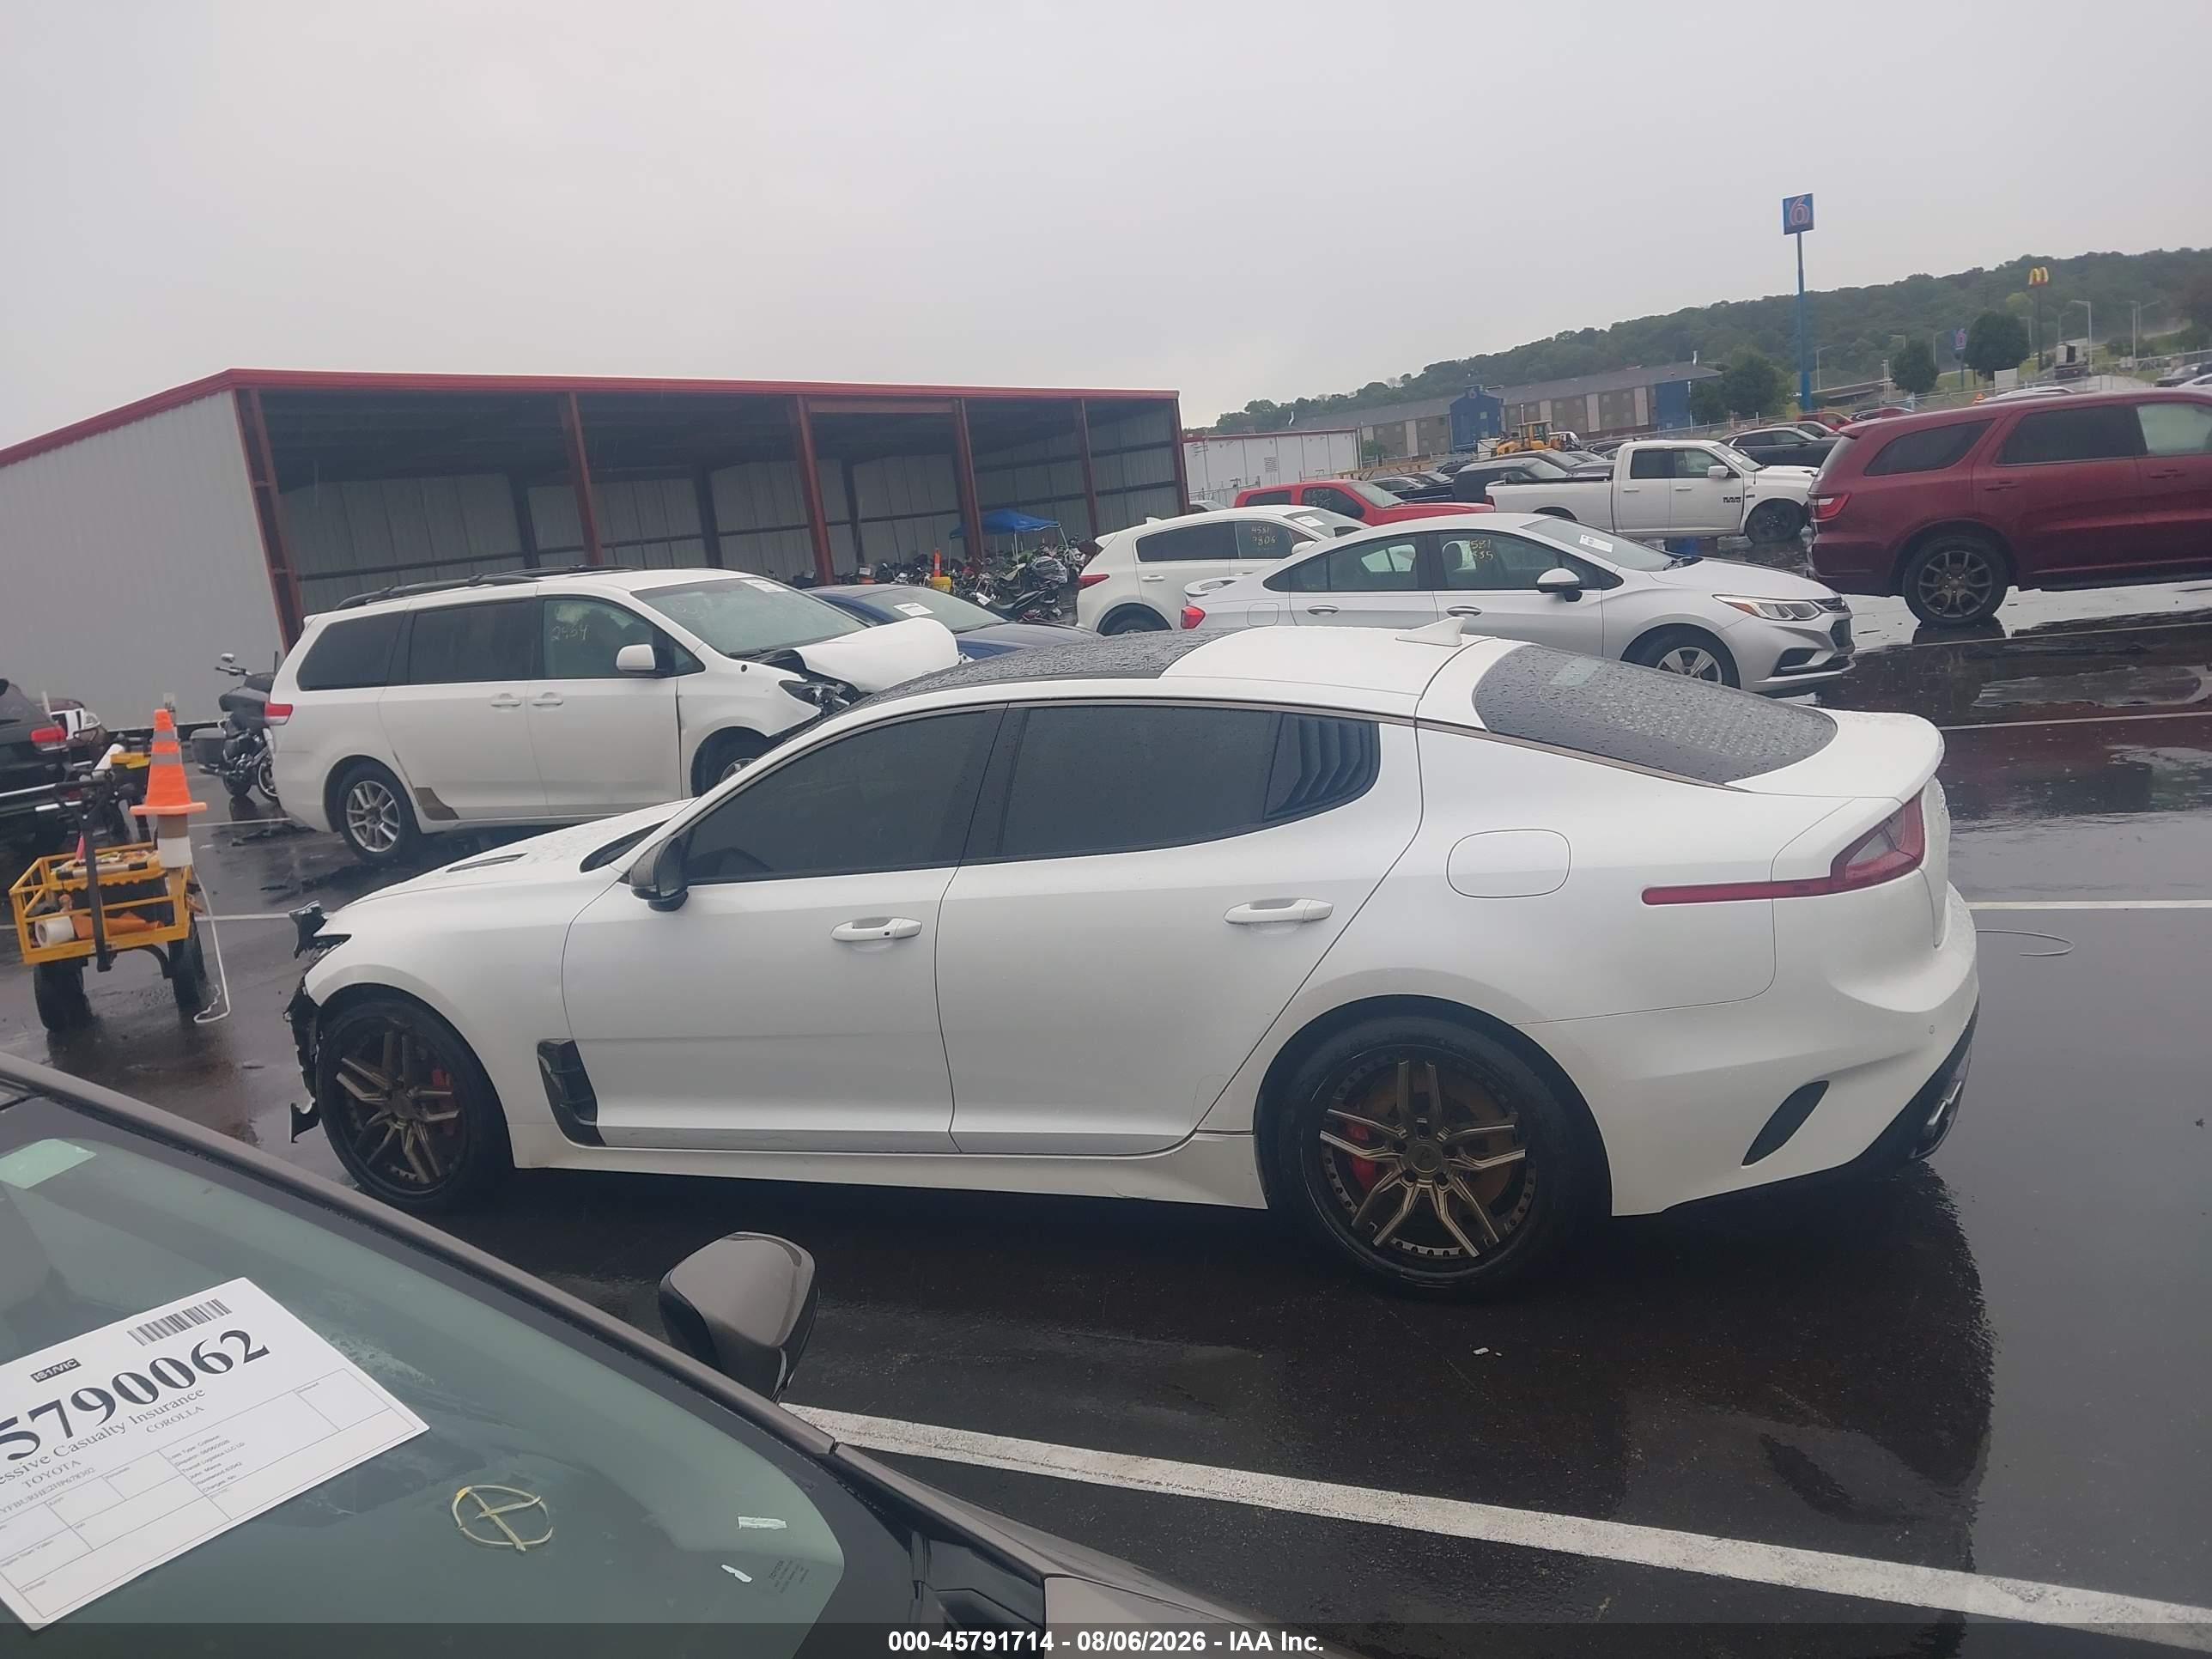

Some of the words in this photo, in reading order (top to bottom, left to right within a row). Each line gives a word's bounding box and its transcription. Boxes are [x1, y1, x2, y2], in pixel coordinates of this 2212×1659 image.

[1789, 196, 1810, 226] 6
[21, 1460, 82, 1488] TOYOTA
[146, 1406, 204, 1434] COROLLA
[53, 1421, 126, 1458] Casualty
[128, 1389, 206, 1425] Insurance
